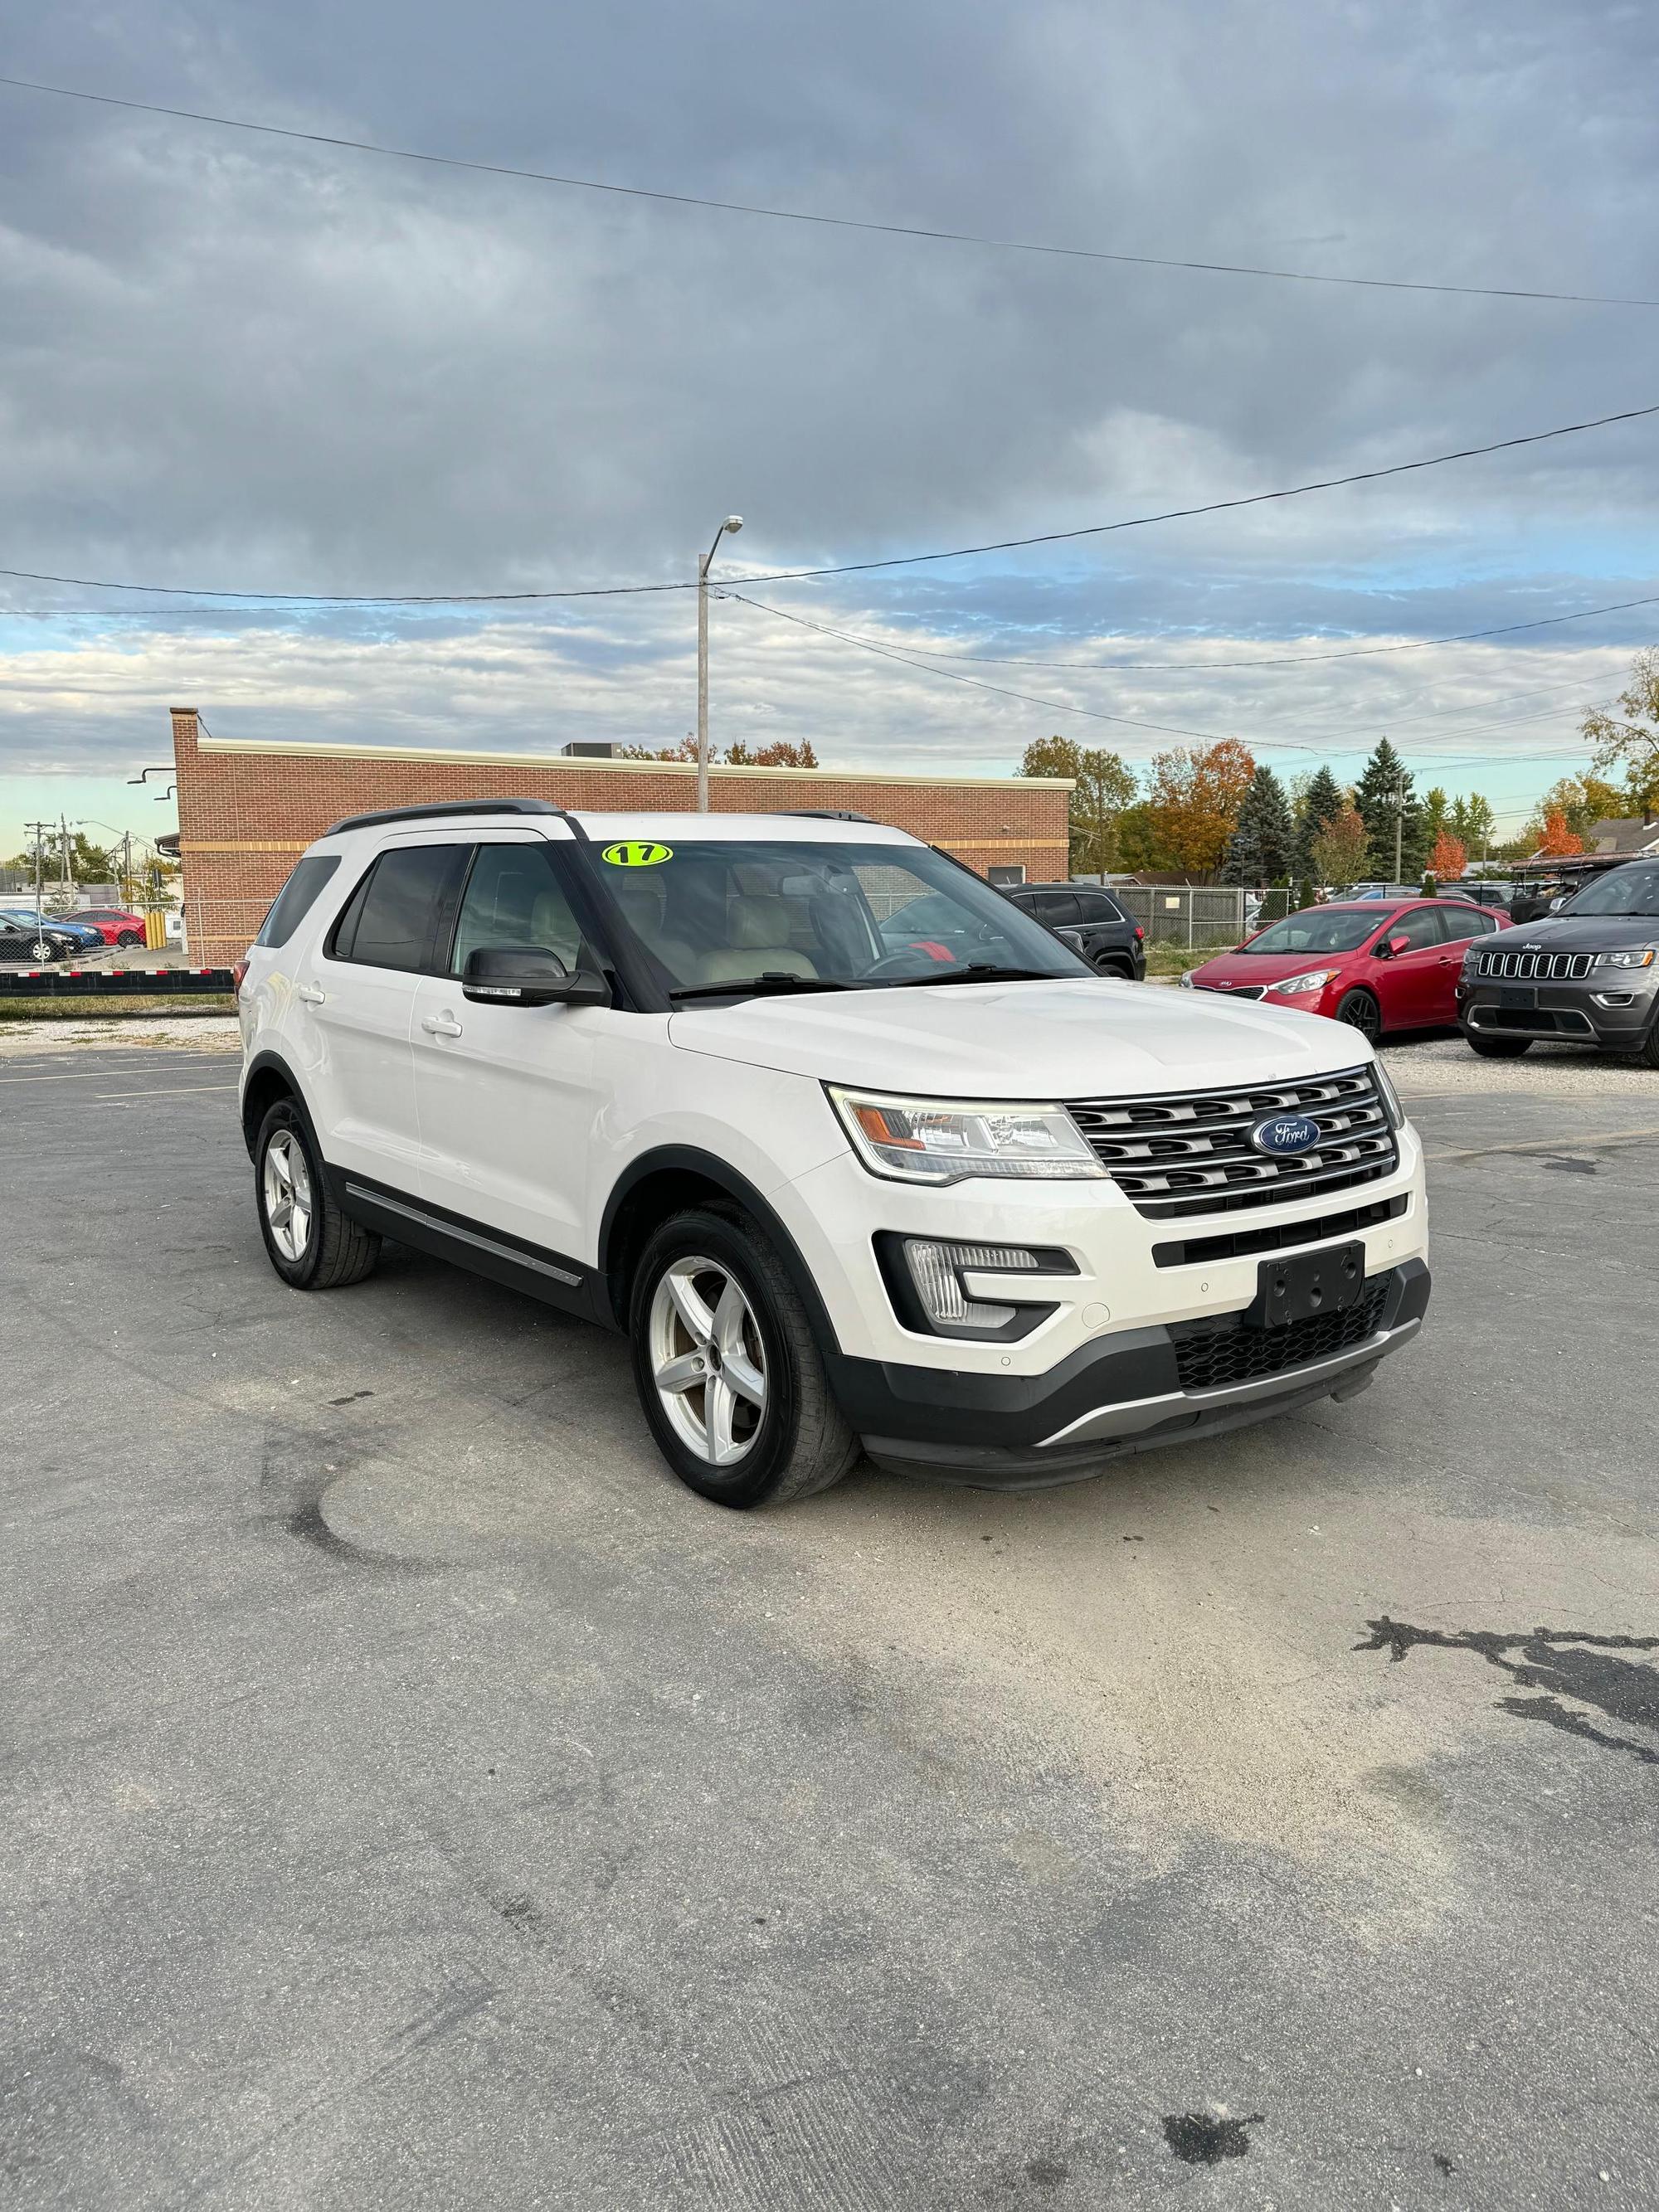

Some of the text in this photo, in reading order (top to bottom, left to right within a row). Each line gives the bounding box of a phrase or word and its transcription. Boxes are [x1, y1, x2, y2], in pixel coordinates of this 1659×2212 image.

[615, 844, 655, 863] 17
[1522, 943, 1541, 951] Jeep
[1275, 1121, 1310, 1145] Ford
